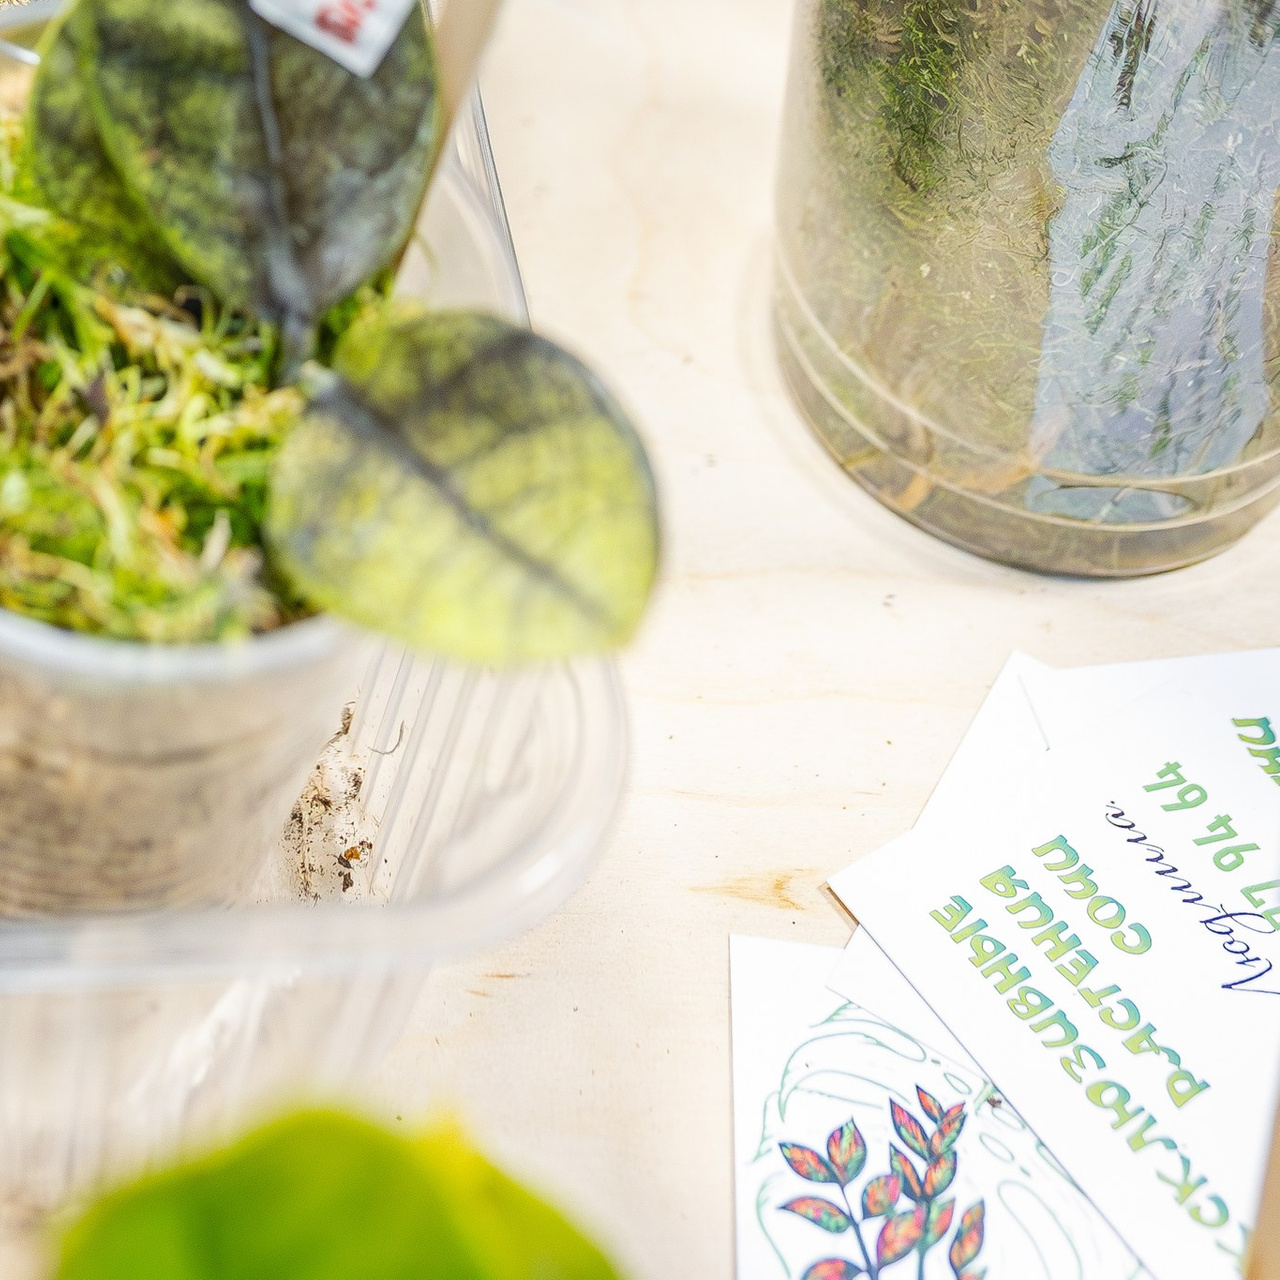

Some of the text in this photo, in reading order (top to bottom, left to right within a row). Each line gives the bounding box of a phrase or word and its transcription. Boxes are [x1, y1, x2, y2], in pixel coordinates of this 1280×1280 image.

[1142, 760, 1209, 813] 64
[1192, 814, 1262, 873] 94
[1031, 834, 1153, 955] СОЧИ
[979, 864, 1211, 1109] РАСТЕНИЯ
